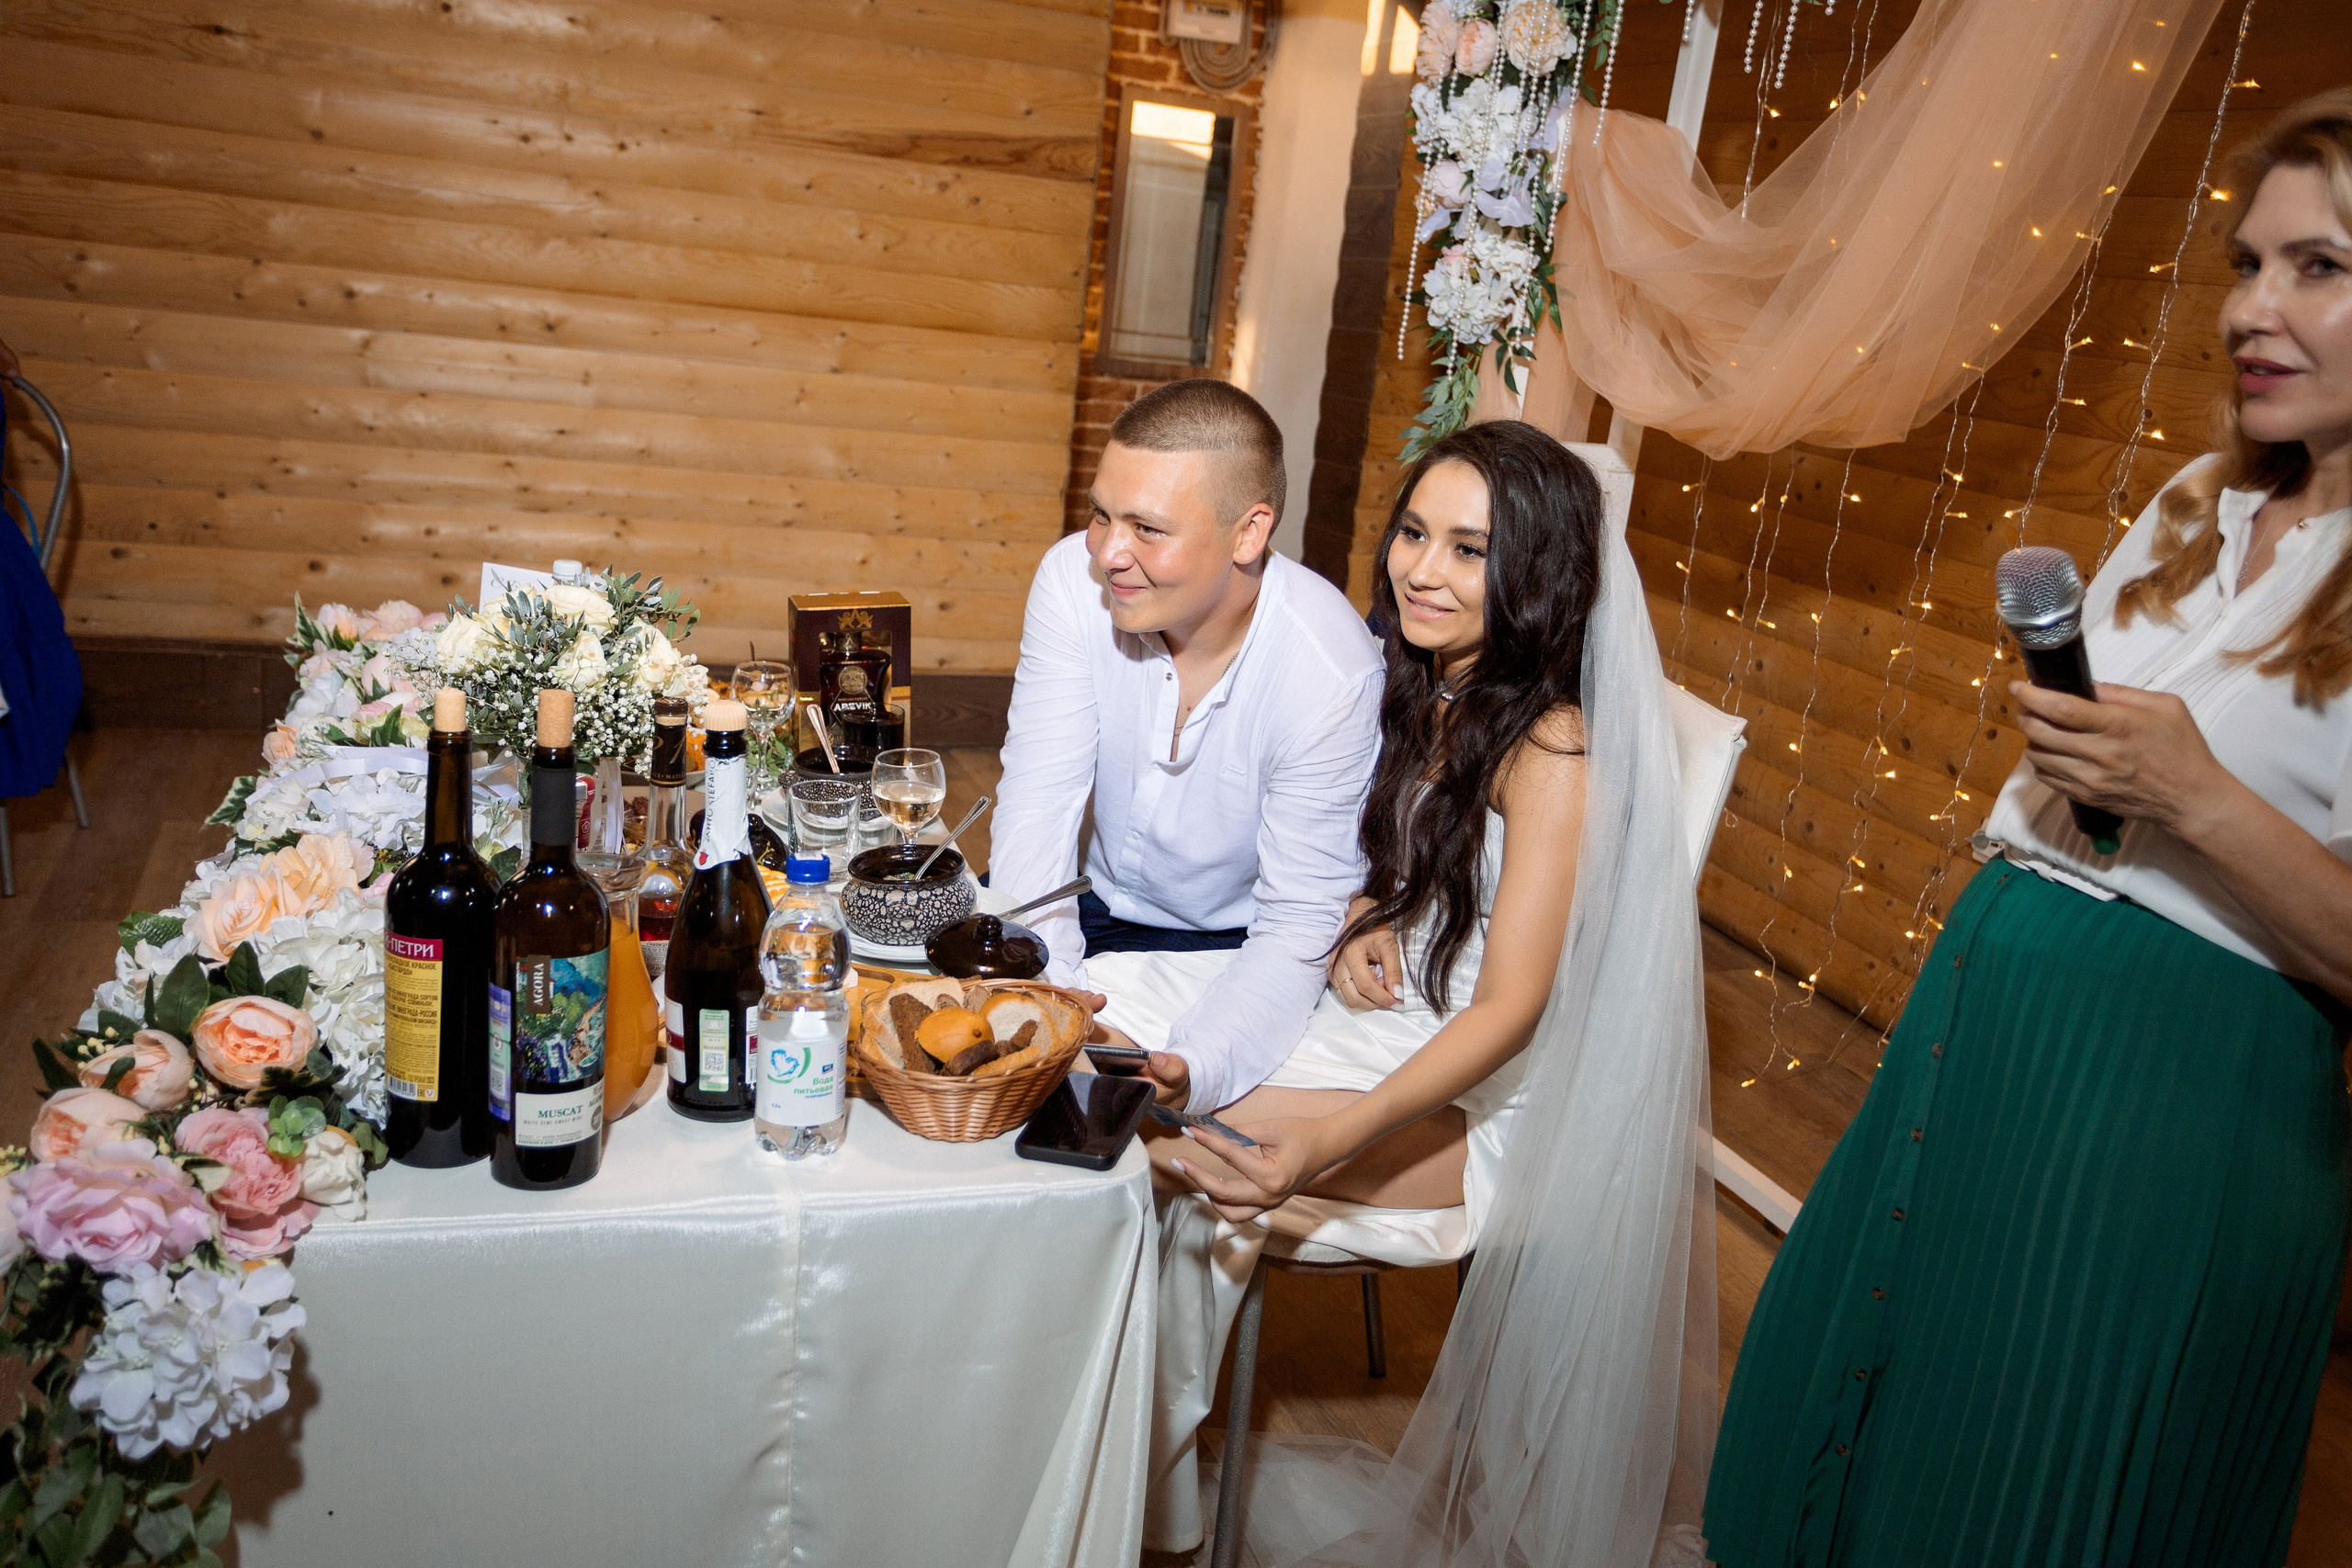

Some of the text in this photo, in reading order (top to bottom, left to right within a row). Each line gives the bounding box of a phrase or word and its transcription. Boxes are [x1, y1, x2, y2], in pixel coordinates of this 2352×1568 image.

[533, 963, 545, 1007] AGORA
[812, 1076, 834, 1086] Вода
[793, 1085, 833, 1095] питьевая
[537, 1104, 583, 1119] MUSCAT
